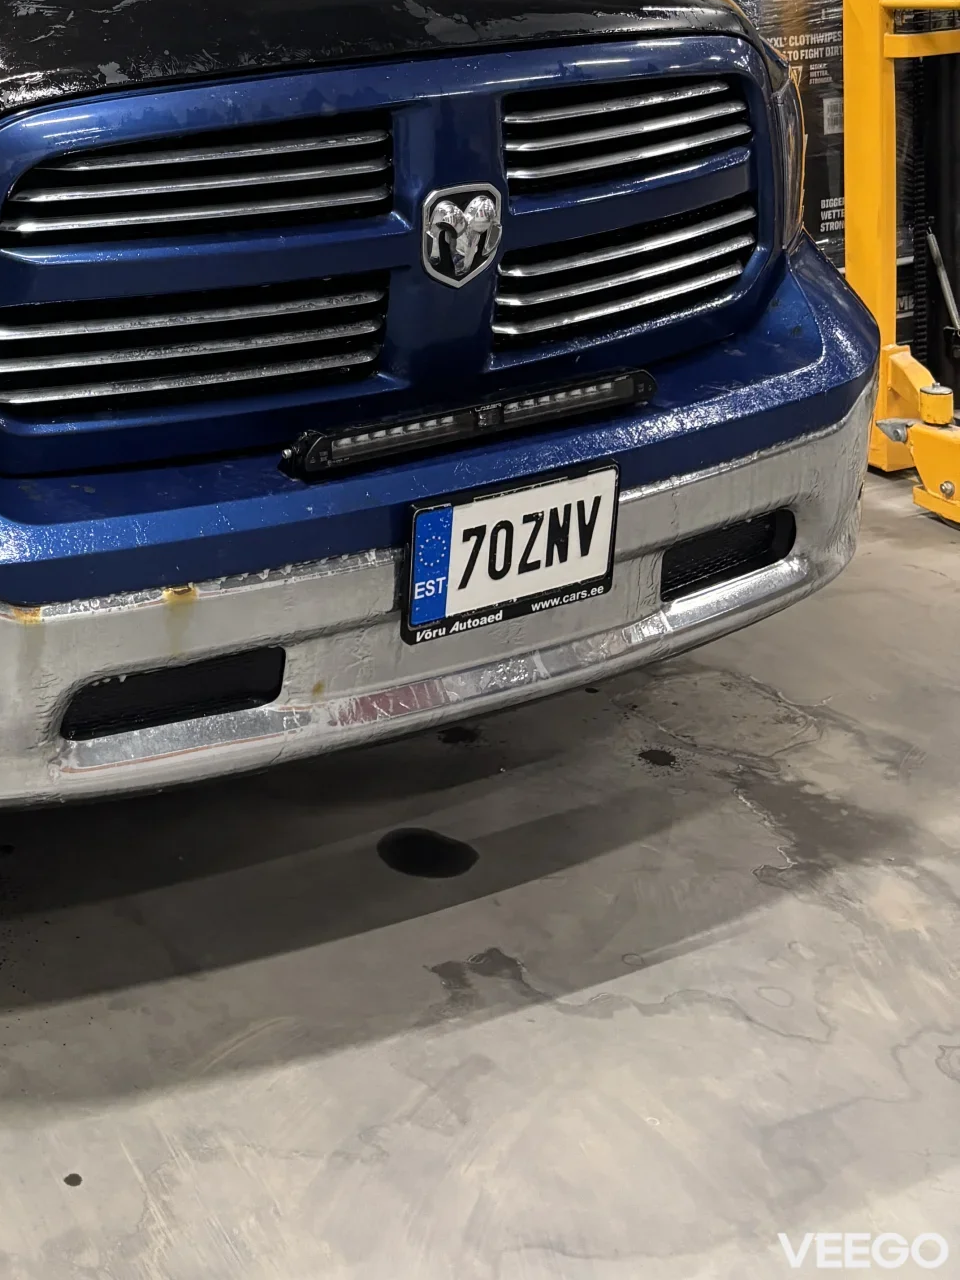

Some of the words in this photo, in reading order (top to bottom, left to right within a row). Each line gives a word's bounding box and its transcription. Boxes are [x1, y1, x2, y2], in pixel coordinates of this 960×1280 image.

[788, 31, 843, 47] CLOTHWIPES
[787, 51, 799, 61] TO
[800, 48, 824, 60] FIGHT
[820, 196, 844, 210] BIGGE
[820, 209, 844, 221] WETTE
[820, 220, 844, 232] STRON
[457, 495, 602, 590] 70ZNV
[413, 576, 447, 600] EST
[531, 585, 604, 613] www.cars.ee
[415, 625, 446, 643] Võru
[449, 609, 504, 633] Autoaed
